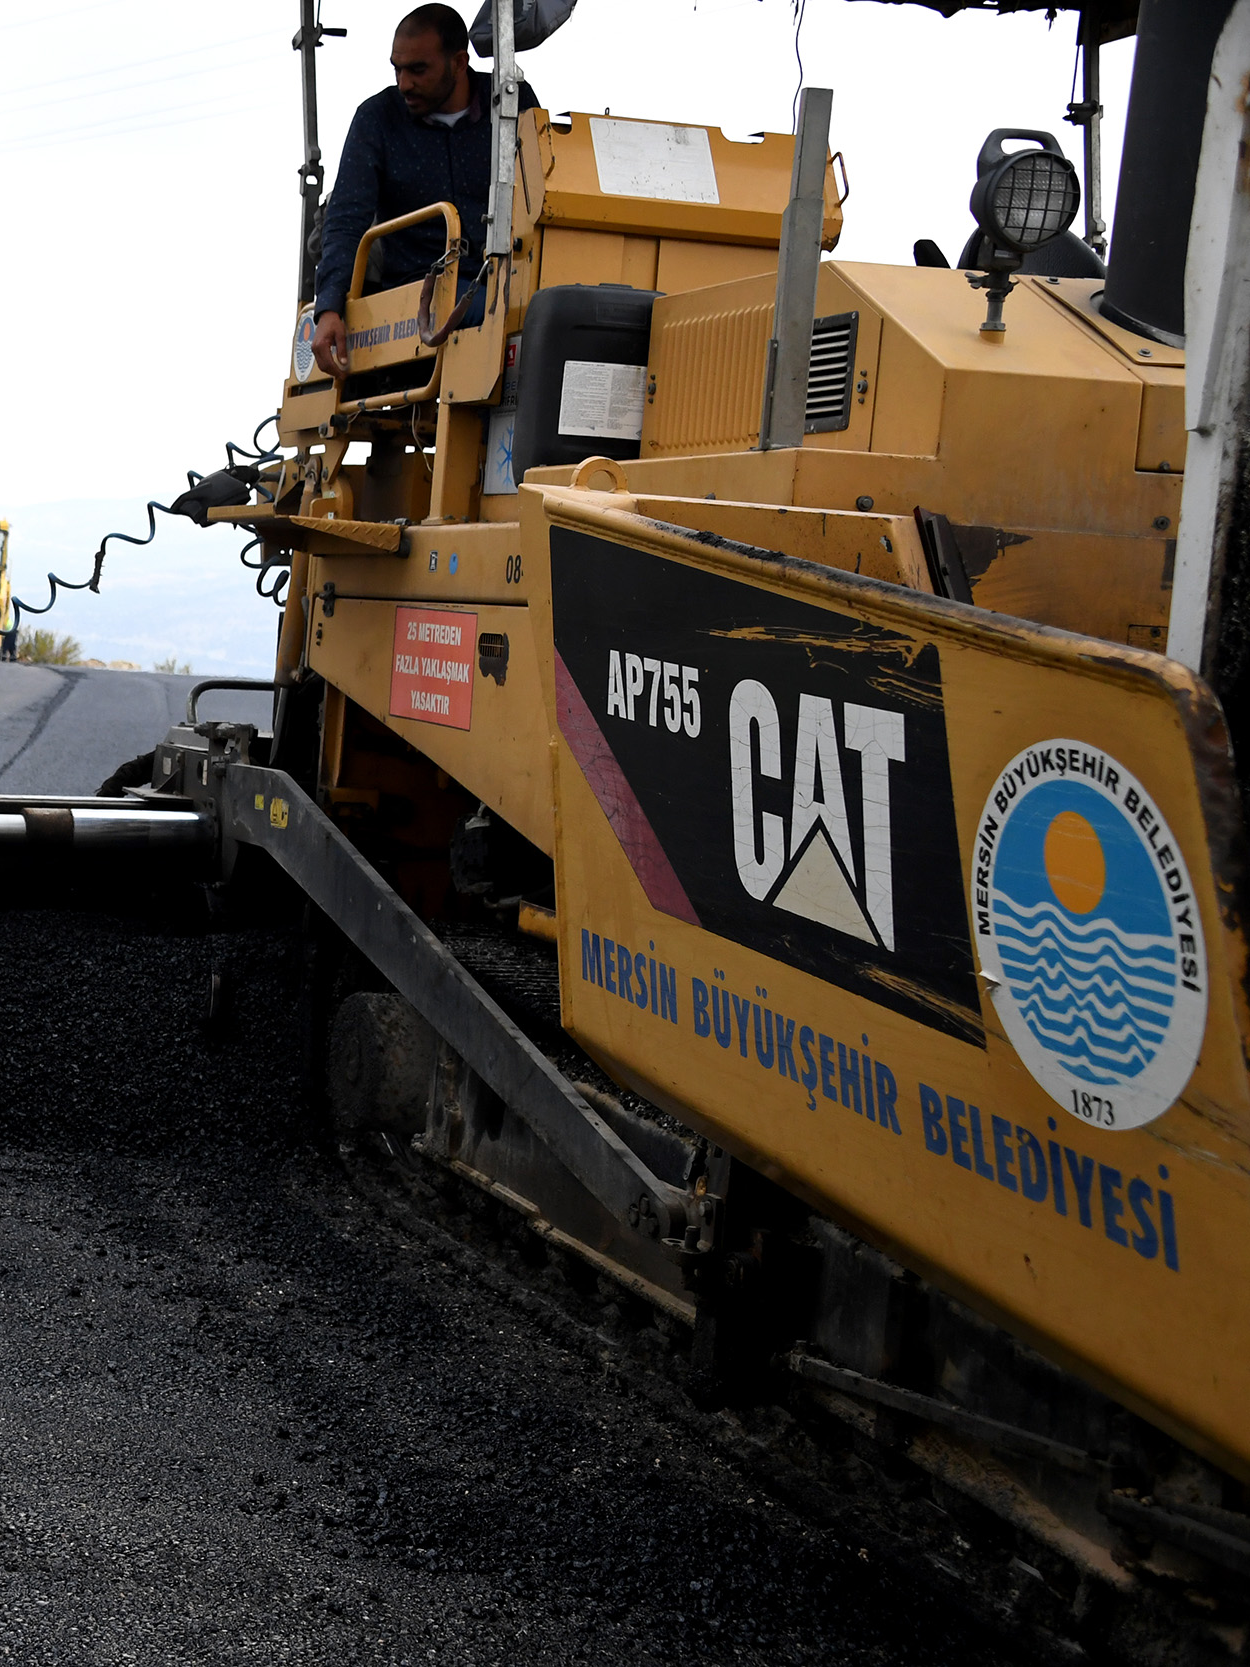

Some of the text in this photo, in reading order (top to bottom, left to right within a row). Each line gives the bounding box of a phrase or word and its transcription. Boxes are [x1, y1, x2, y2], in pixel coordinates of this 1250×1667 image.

[506, 554, 523, 584] 08
[407, 621, 462, 646] 25 METREDEN
[395, 654, 470, 685] FAZLA YAKLAŞMAK
[411, 690, 450, 715] YASAKTIR
[607, 649, 701, 738] AP755
[729, 678, 906, 952] CAT
[978, 747, 1202, 993] MERSİN BÜYÜKŞEHİR BELEDİYESİ
[581, 928, 1181, 1272] MERSİN BÜYÜKŞEHİR BELEDİYESİ
[1070, 1088, 1115, 1126] 1873
